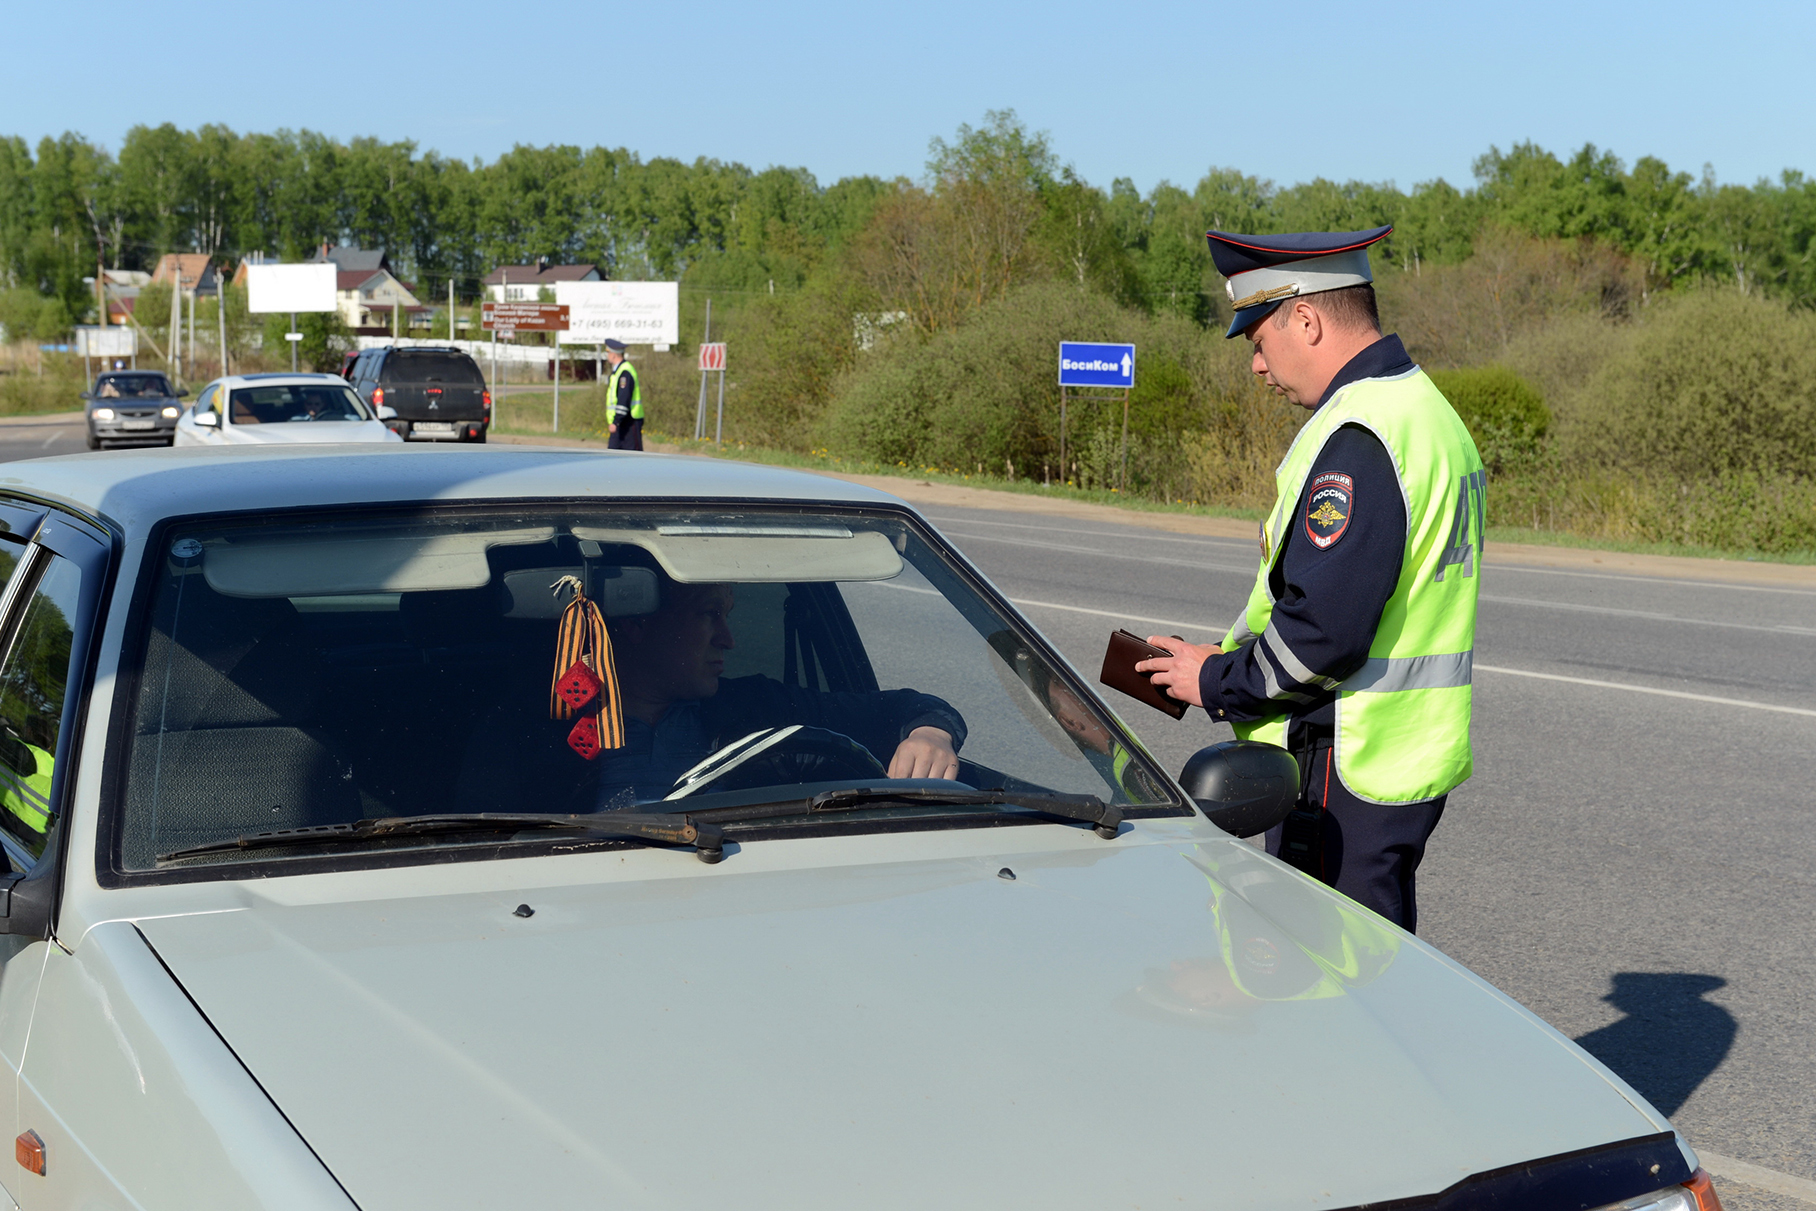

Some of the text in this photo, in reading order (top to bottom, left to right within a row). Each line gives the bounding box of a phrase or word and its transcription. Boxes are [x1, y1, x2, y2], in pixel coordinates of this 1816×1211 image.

[572, 319, 584, 328] +7
[586, 319, 612, 330] (495)
[1062, 359, 1118, 372] БосиКом
[1314, 474, 1350, 487] ПОЛИЦИЯ
[1312, 489, 1347, 504] РОССИЯ
[1315, 535, 1332, 548] МВД
